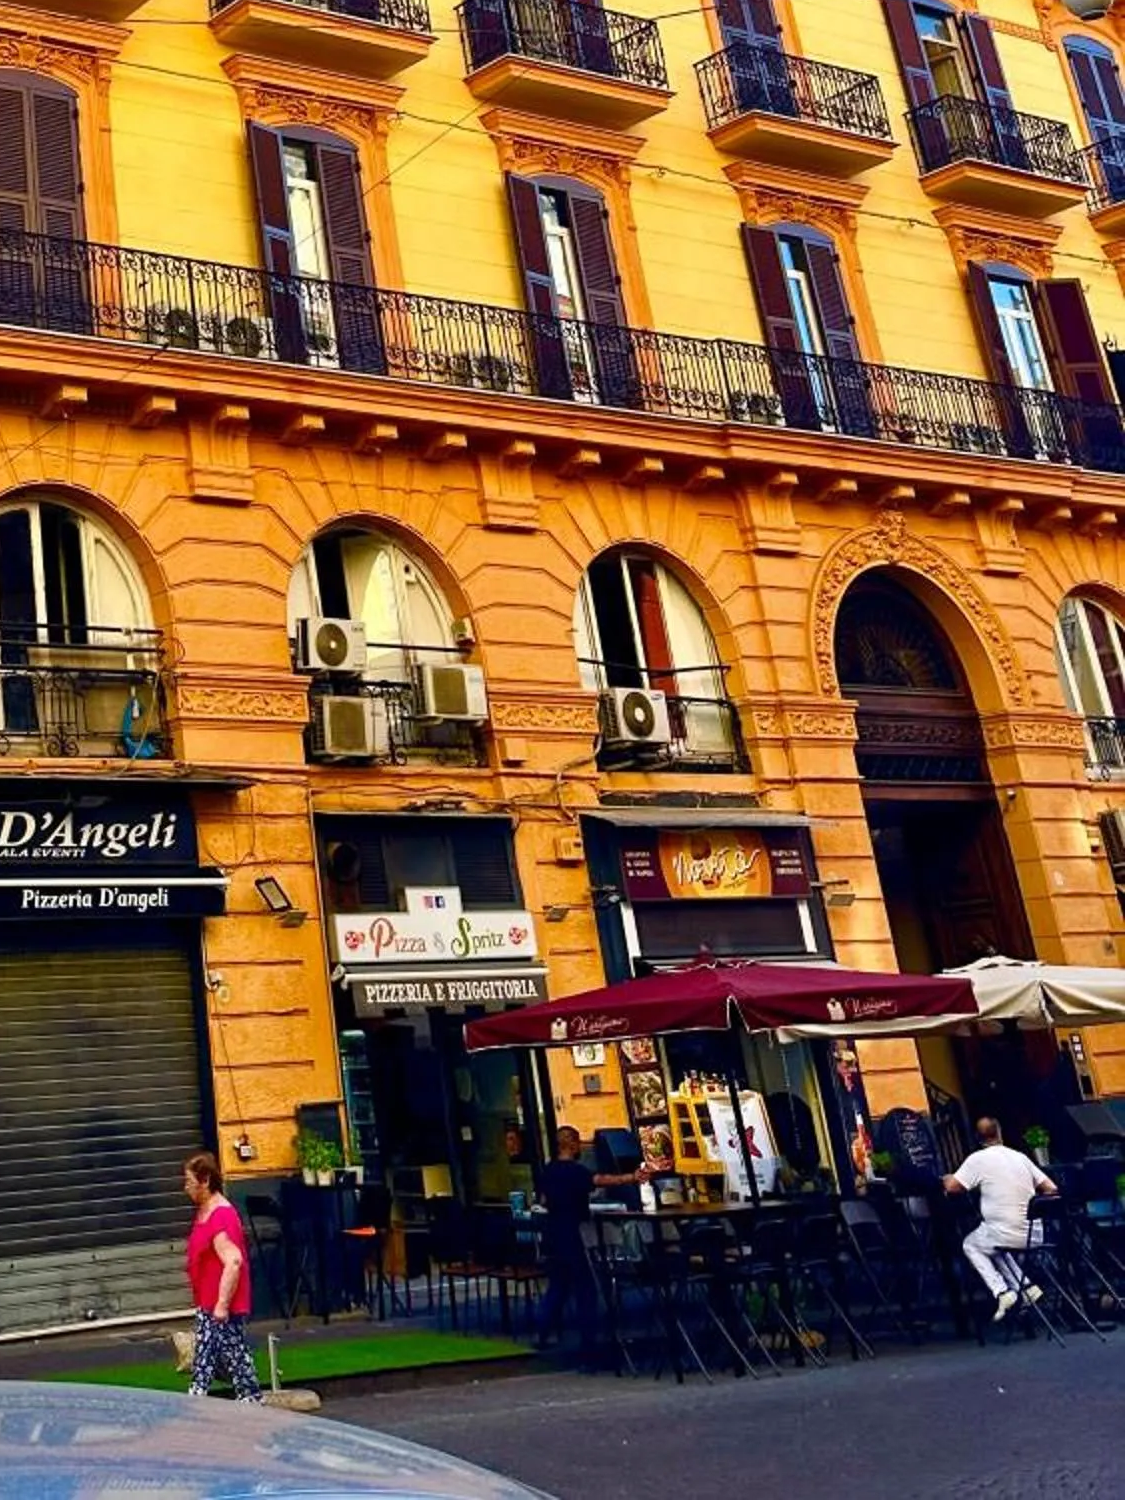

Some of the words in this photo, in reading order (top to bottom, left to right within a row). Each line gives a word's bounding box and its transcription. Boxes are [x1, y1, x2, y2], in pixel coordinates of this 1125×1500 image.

[32, 847, 86, 858] EVENTI
[20, 888, 93, 909] Pizzeria
[98, 887, 170, 913] D'angeli
[369, 917, 427, 958] Pizza
[450, 916, 507, 957] Spritz
[364, 982, 431, 1003] PIZZERIA
[435, 982, 446, 1001] E
[448, 978, 539, 1001] FRIGGITORIA
